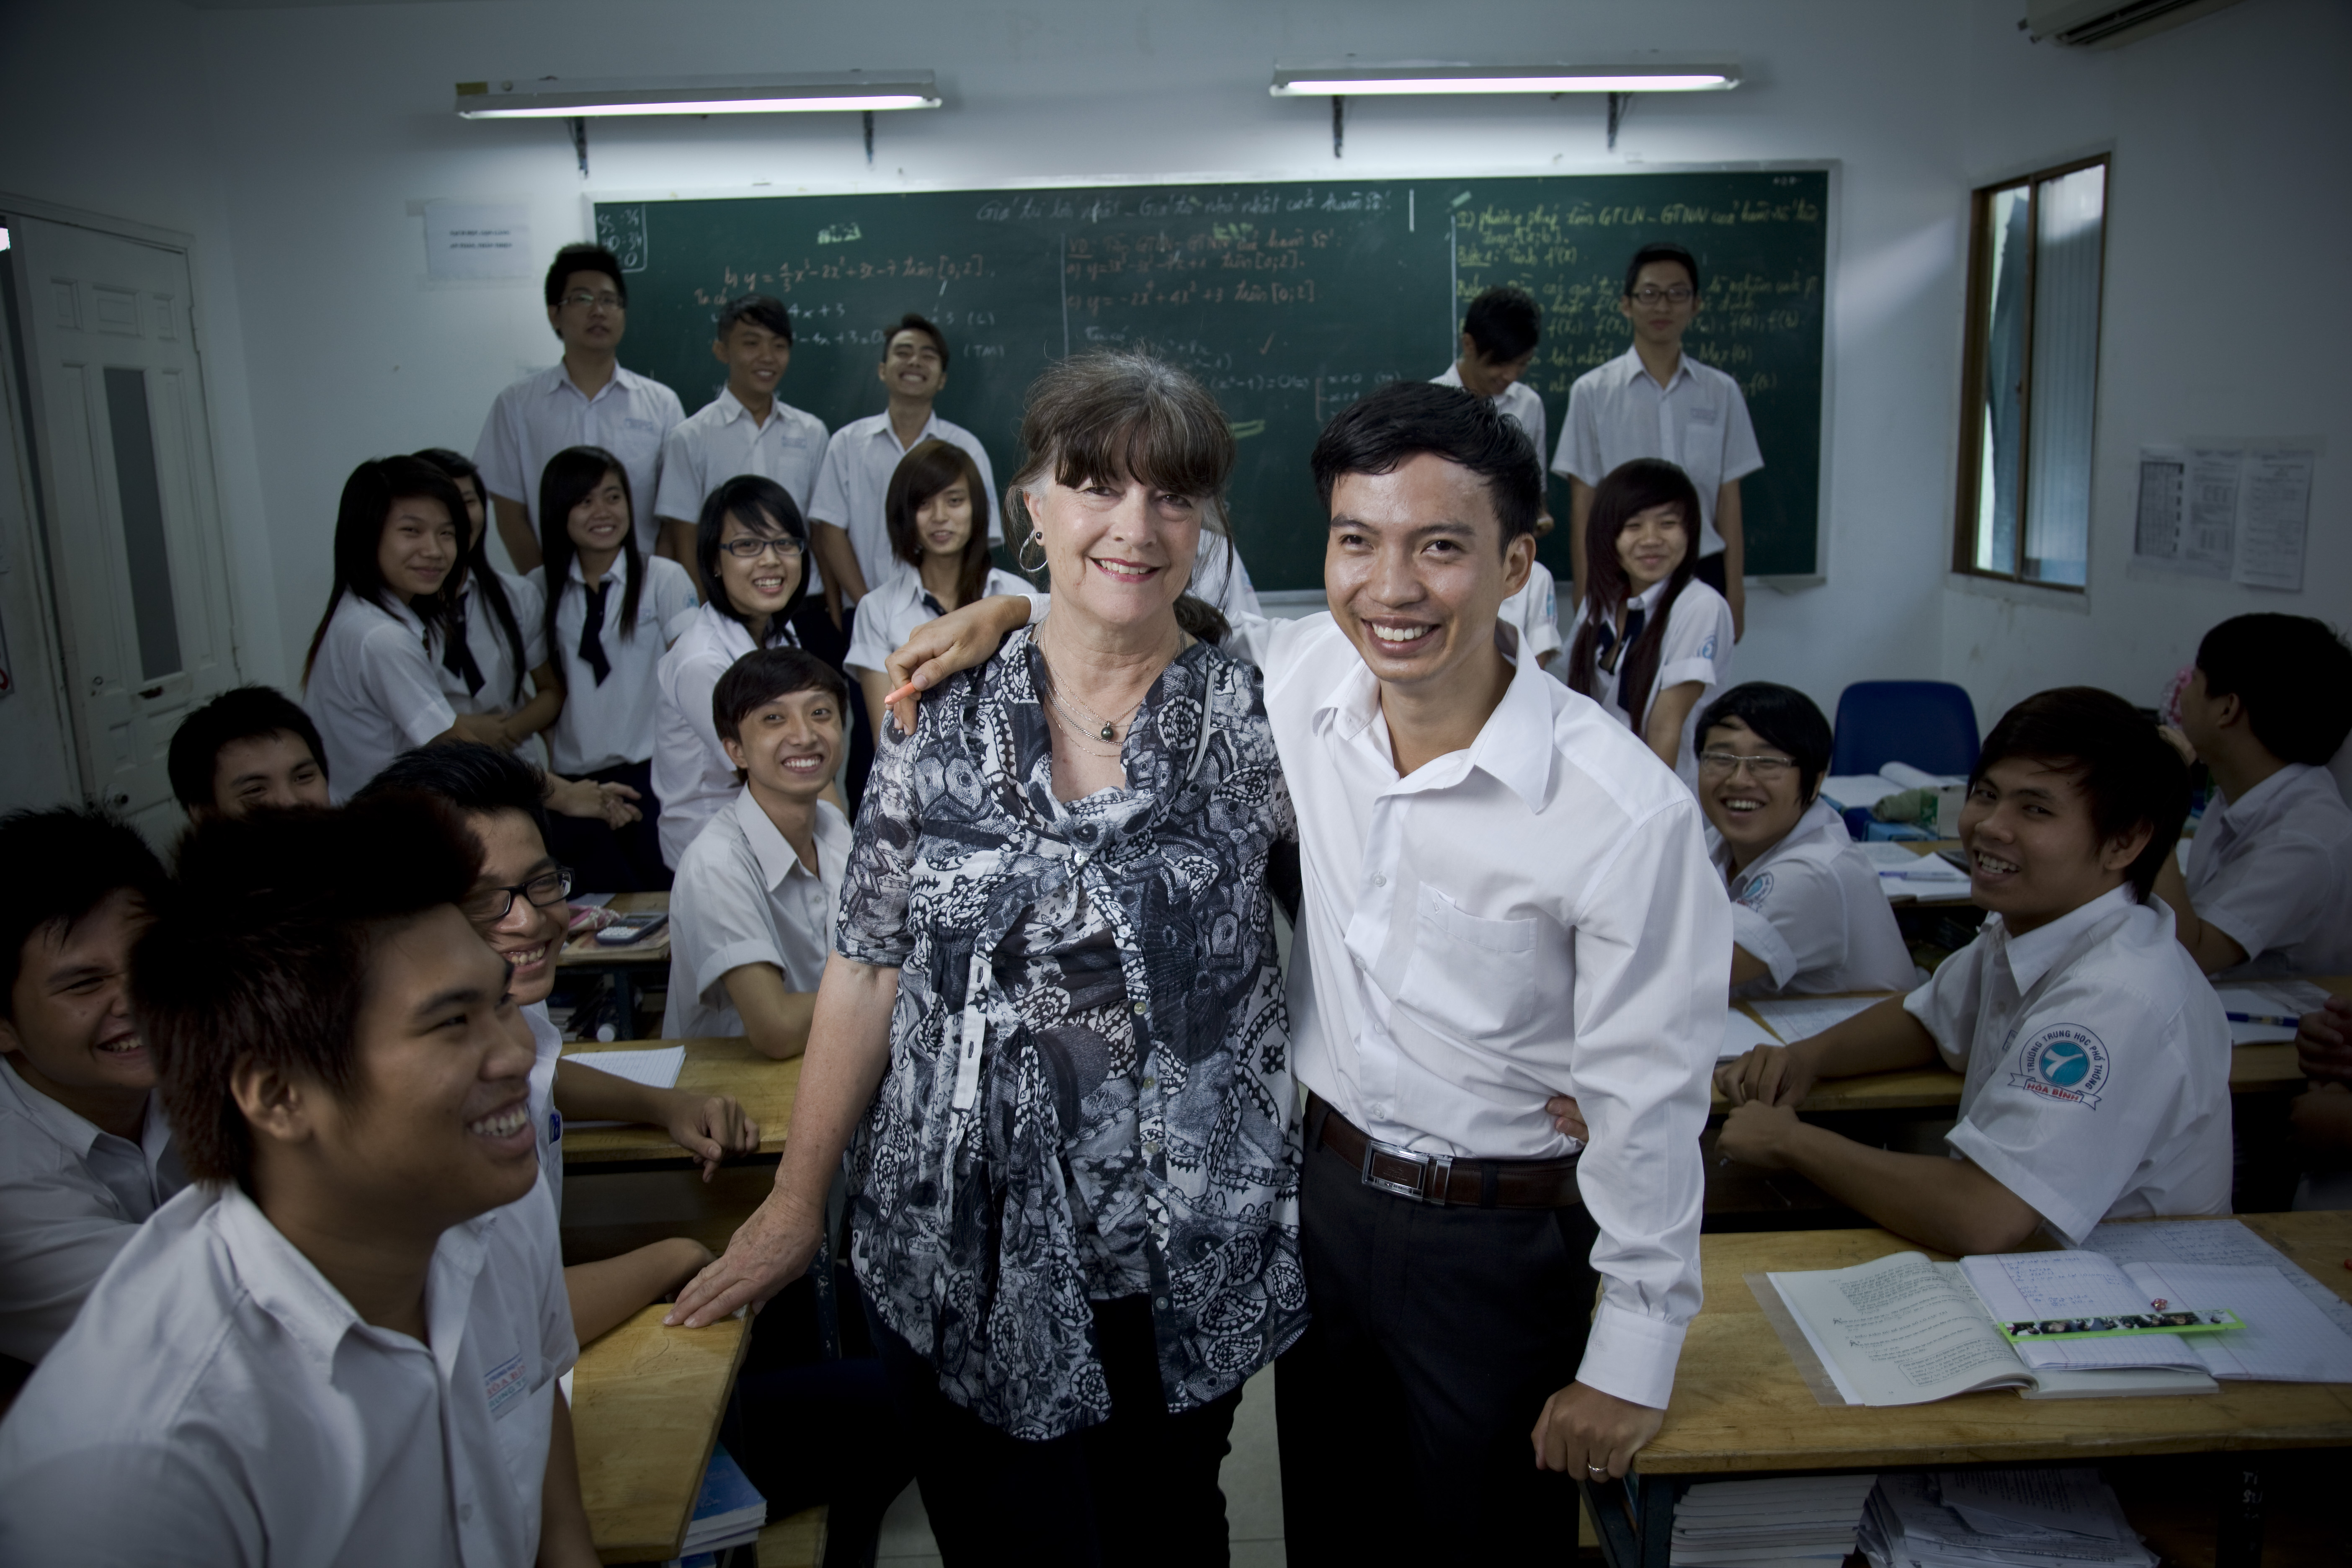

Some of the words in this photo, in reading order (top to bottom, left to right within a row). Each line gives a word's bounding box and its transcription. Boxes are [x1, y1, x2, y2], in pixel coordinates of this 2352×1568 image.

[2042, 1030, 2071, 1042] TRUNG
[2074, 1032, 2091, 1046] HỌC
[2027, 1041, 2042, 1072] TRƯỜNG
[2089, 1045, 2105, 1061] PHỔ
[2085, 1064, 2102, 1090] THÔNG
[2027, 1083, 2049, 1093] HÒA
[2052, 1089, 2079, 1101] BÌNH
